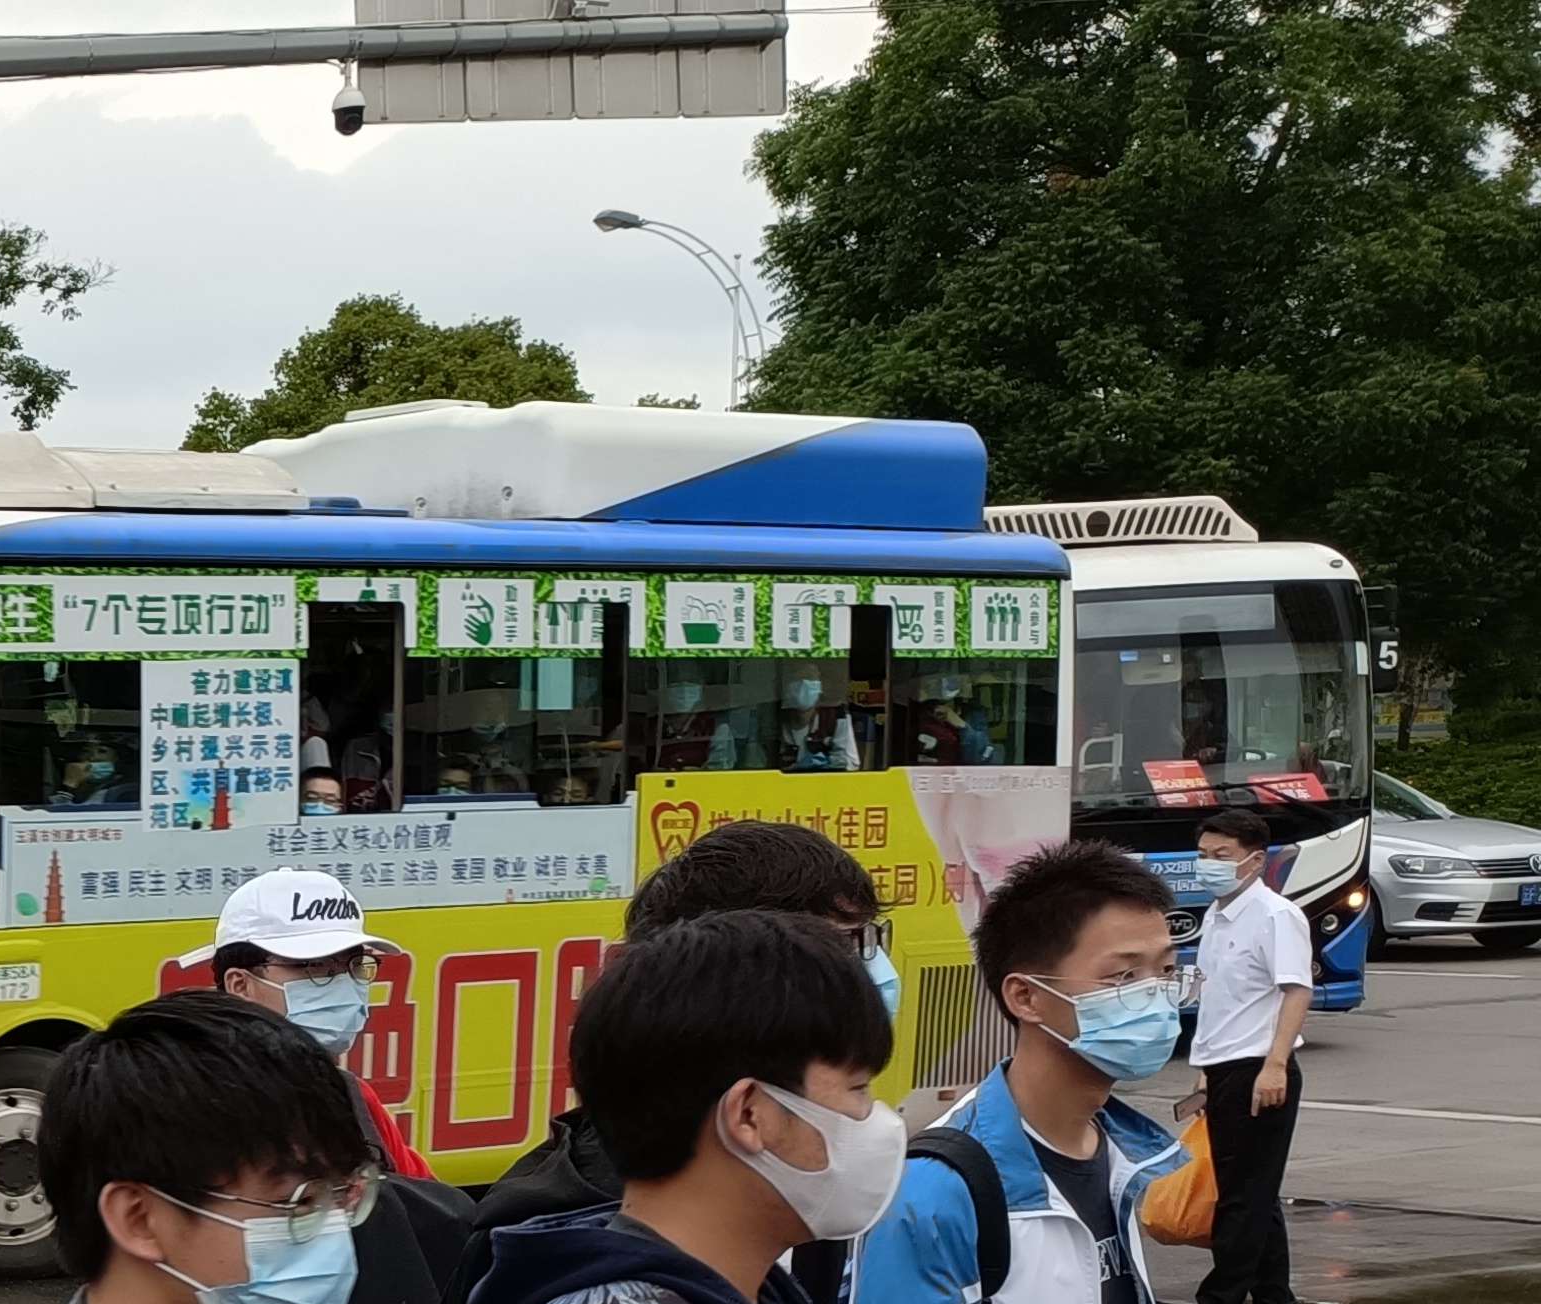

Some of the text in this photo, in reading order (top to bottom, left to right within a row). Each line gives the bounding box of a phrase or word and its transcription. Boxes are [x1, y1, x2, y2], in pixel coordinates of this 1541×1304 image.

[1378, 641, 1399, 669] 5
[151, 733, 293, 763] 乡村振兴示范
[150, 801, 190, 829] 范区
[266, 824, 454, 853] 社会主义核心价值观
[80, 871, 120, 896] 富强
[128, 869, 167, 894] 民主
[174, 867, 214, 892] 文明
[359, 861, 396, 883] 公正
[403, 859, 438, 882] 法治
[451, 857, 486, 881] 爱国
[493, 856, 527, 879] 敬业
[534, 855, 568, 877] 诚信
[574, 854, 609, 877] 友善
